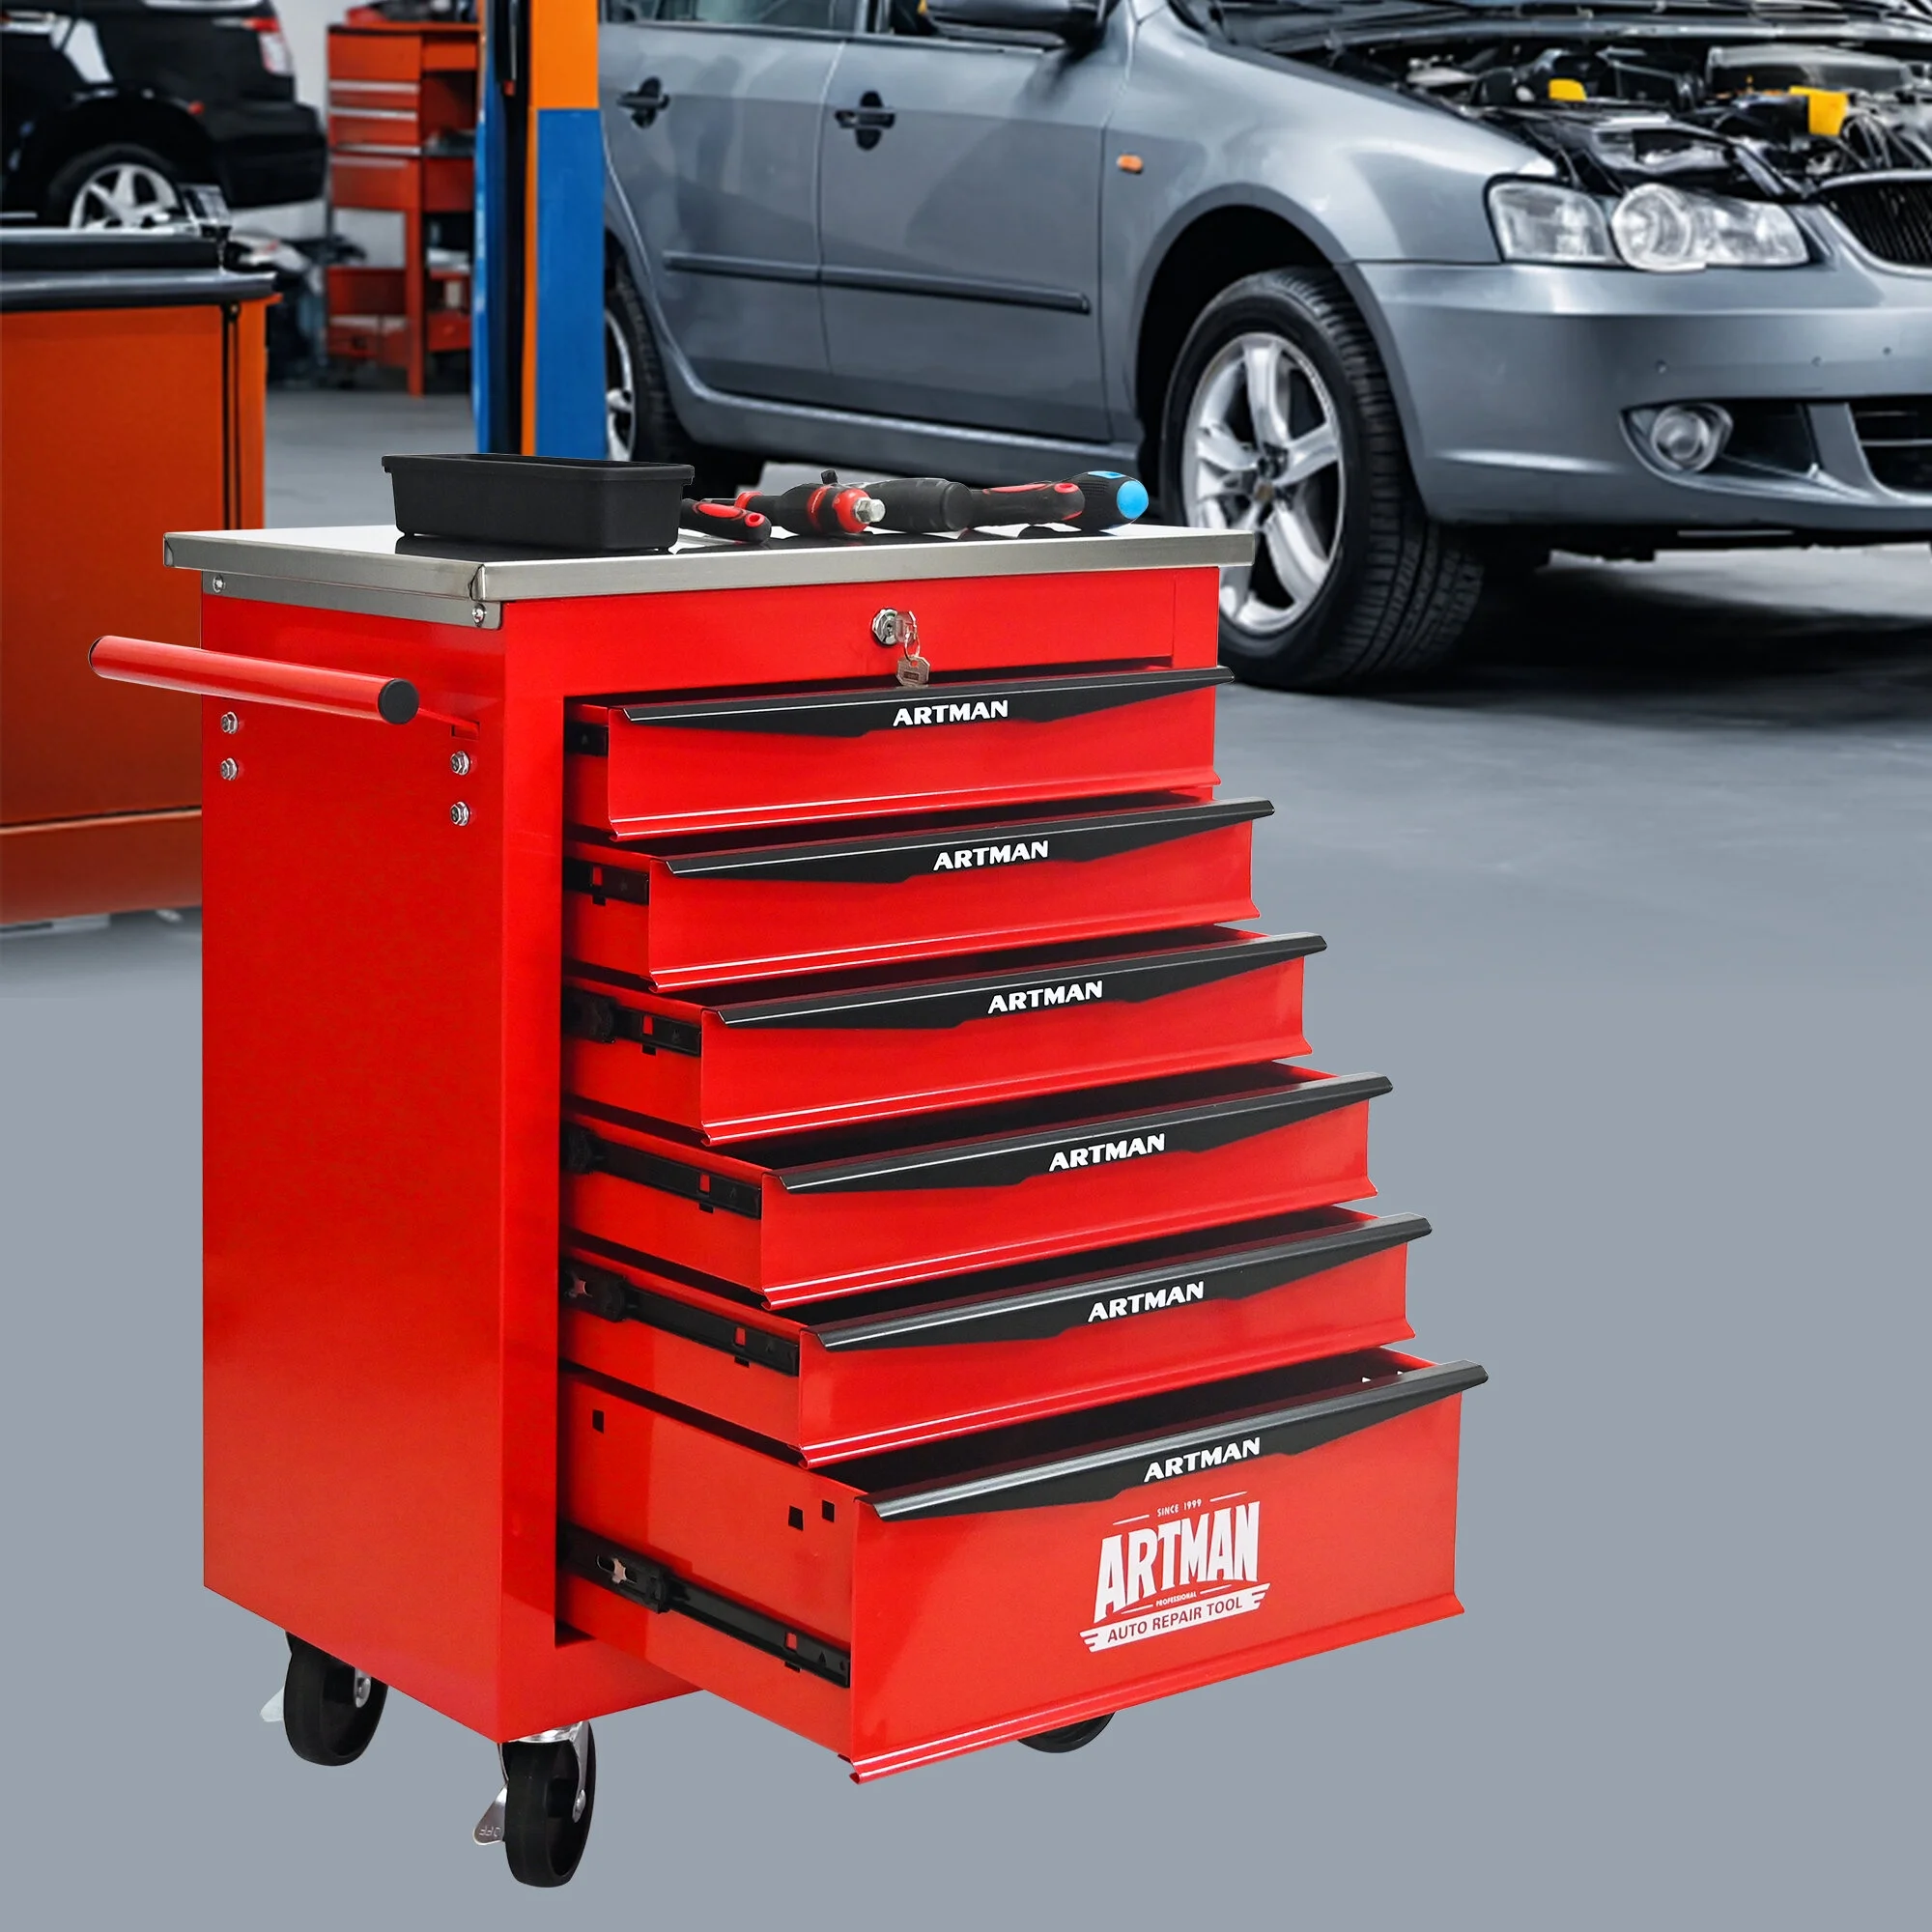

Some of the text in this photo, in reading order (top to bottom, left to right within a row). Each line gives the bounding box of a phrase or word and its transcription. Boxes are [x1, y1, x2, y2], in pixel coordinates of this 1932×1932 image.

[893, 699, 1009, 727] ARTMAN
[933, 839, 1049, 869] ARTMAN
[987, 980, 1103, 1014] ARTMAN
[1048, 1133, 1165, 1172] ARTMAN
[1087, 1281, 1205, 1322] ARTMAN
[1143, 1436, 1261, 1483] ARTMAN
[1156, 1498, 1203, 1518] SINCE 1999
[1094, 1500, 1261, 1624] ARTMAN
[1155, 1591, 1197, 1607] PROFESSIONAL
[1107, 1596, 1243, 1643] AUTO REPAIR TOOL
